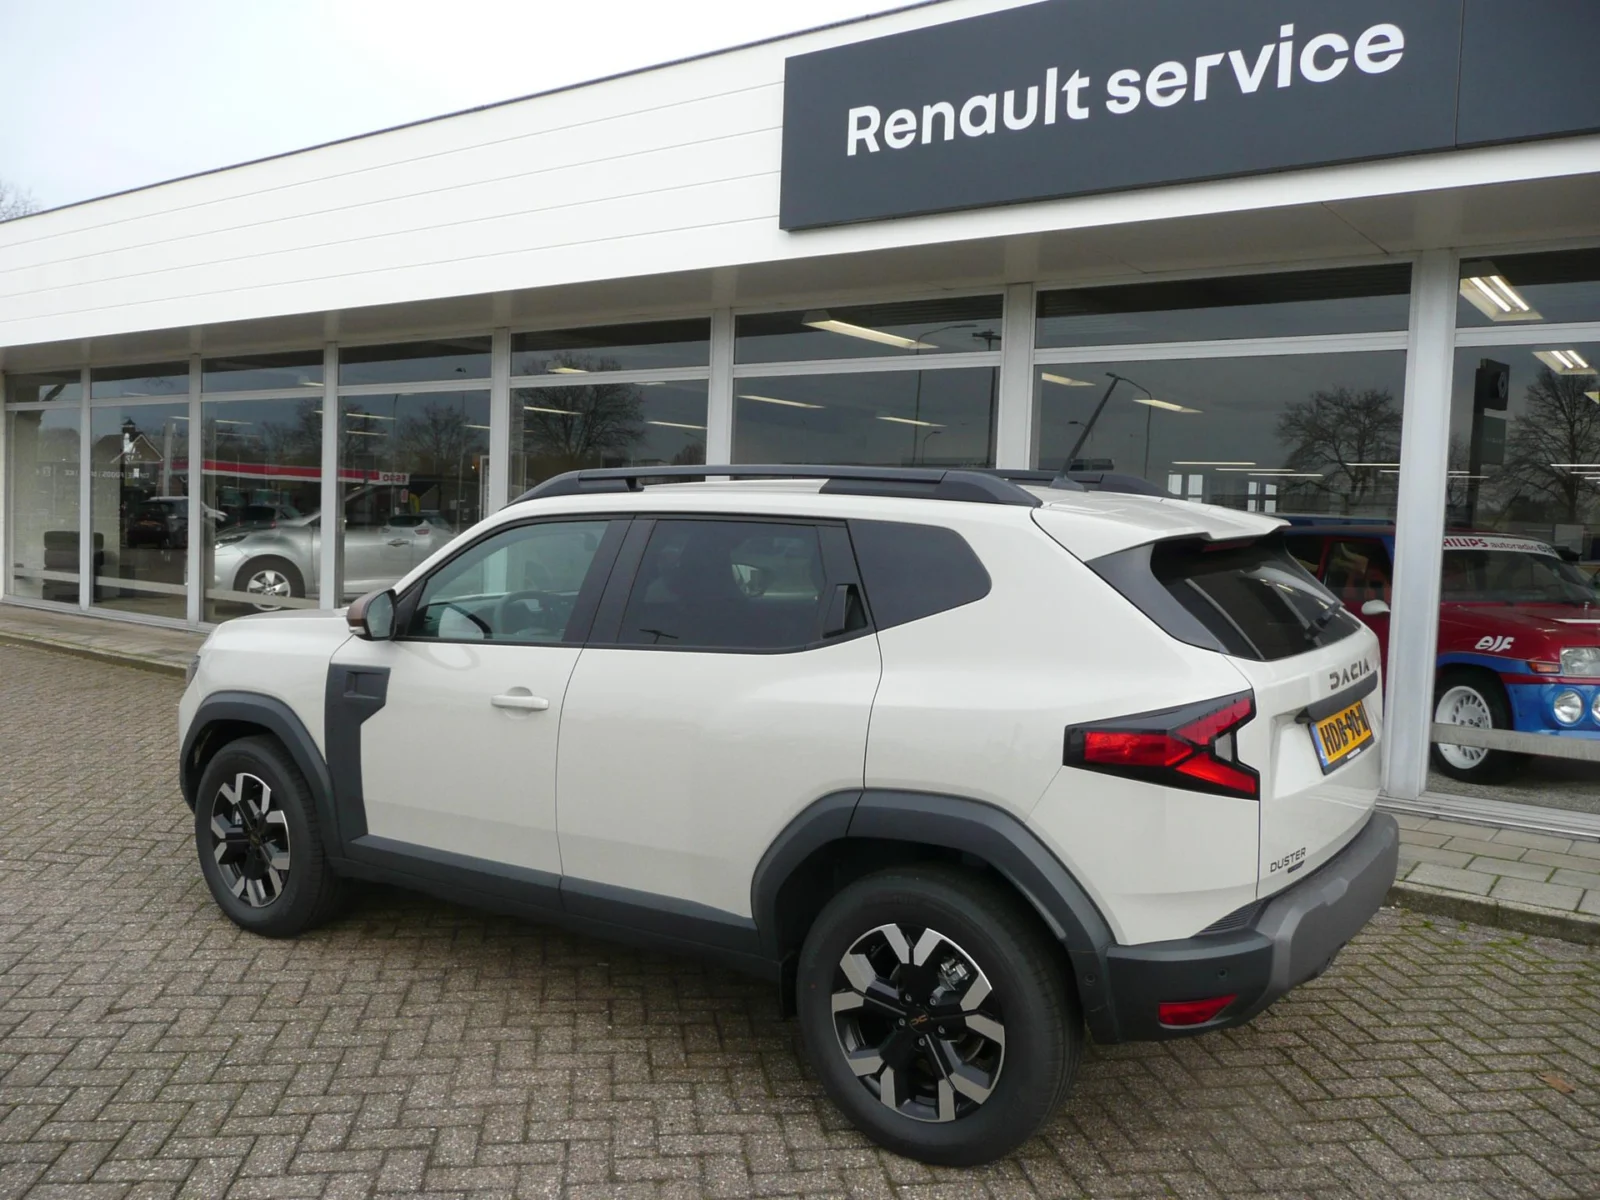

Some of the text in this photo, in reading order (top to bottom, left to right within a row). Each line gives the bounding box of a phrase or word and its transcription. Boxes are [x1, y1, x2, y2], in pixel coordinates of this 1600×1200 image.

[847, 23, 1405, 156] Renault service
[1443, 538, 1489, 548] HILIPS
[1490, 542, 1537, 551] autoradio
[1475, 635, 1515, 652] elf
[1329, 657, 1370, 690] DACIA
[1270, 846, 1306, 873] DUSTER
